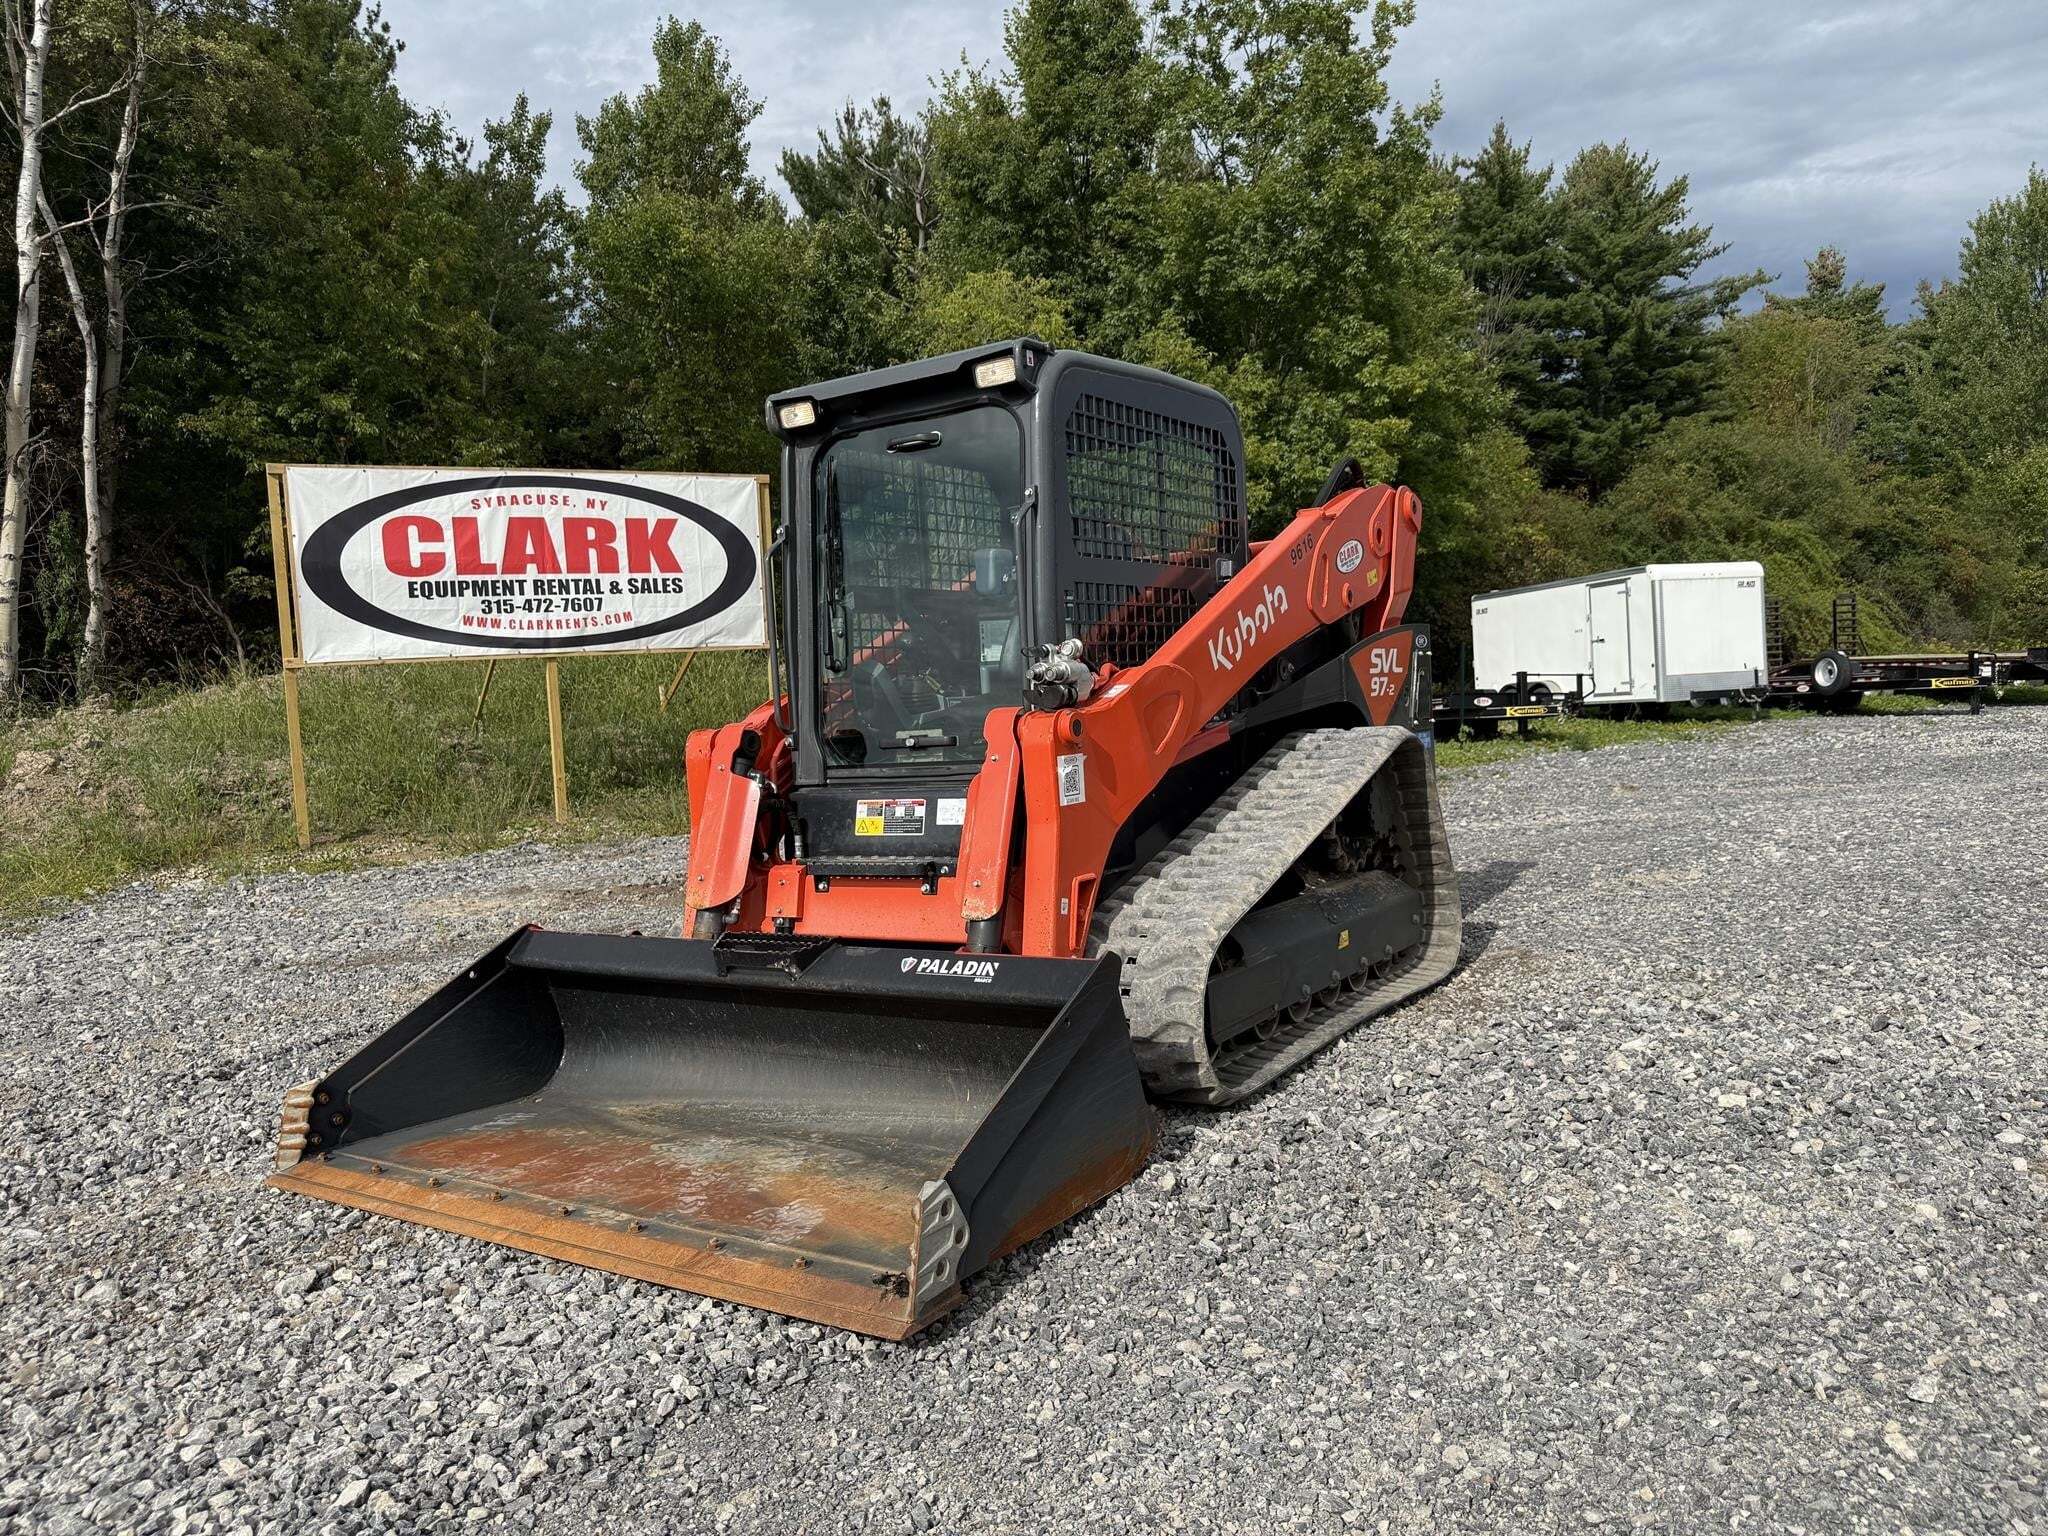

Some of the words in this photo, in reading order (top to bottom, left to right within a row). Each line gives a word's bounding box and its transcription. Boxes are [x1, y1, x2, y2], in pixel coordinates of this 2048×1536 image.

[586, 498, 608, 511] NY
[381, 515, 684, 577] CLARK
[1290, 533, 1314, 565] 9616
[408, 579, 527, 600] EQUIPMENT
[533, 578, 604, 596] RENTAL
[609, 580, 623, 595] &
[627, 578, 683, 594] SALES
[481, 597, 603, 614] 315-472-7607
[463, 611, 633, 631] WWW.CLARKRENTS.COM
[1208, 584, 1288, 671] Kubota
[1369, 648, 1403, 674] SVL
[1370, 676, 1395, 697] 97-2
[916, 958, 999, 976] PALADIN
